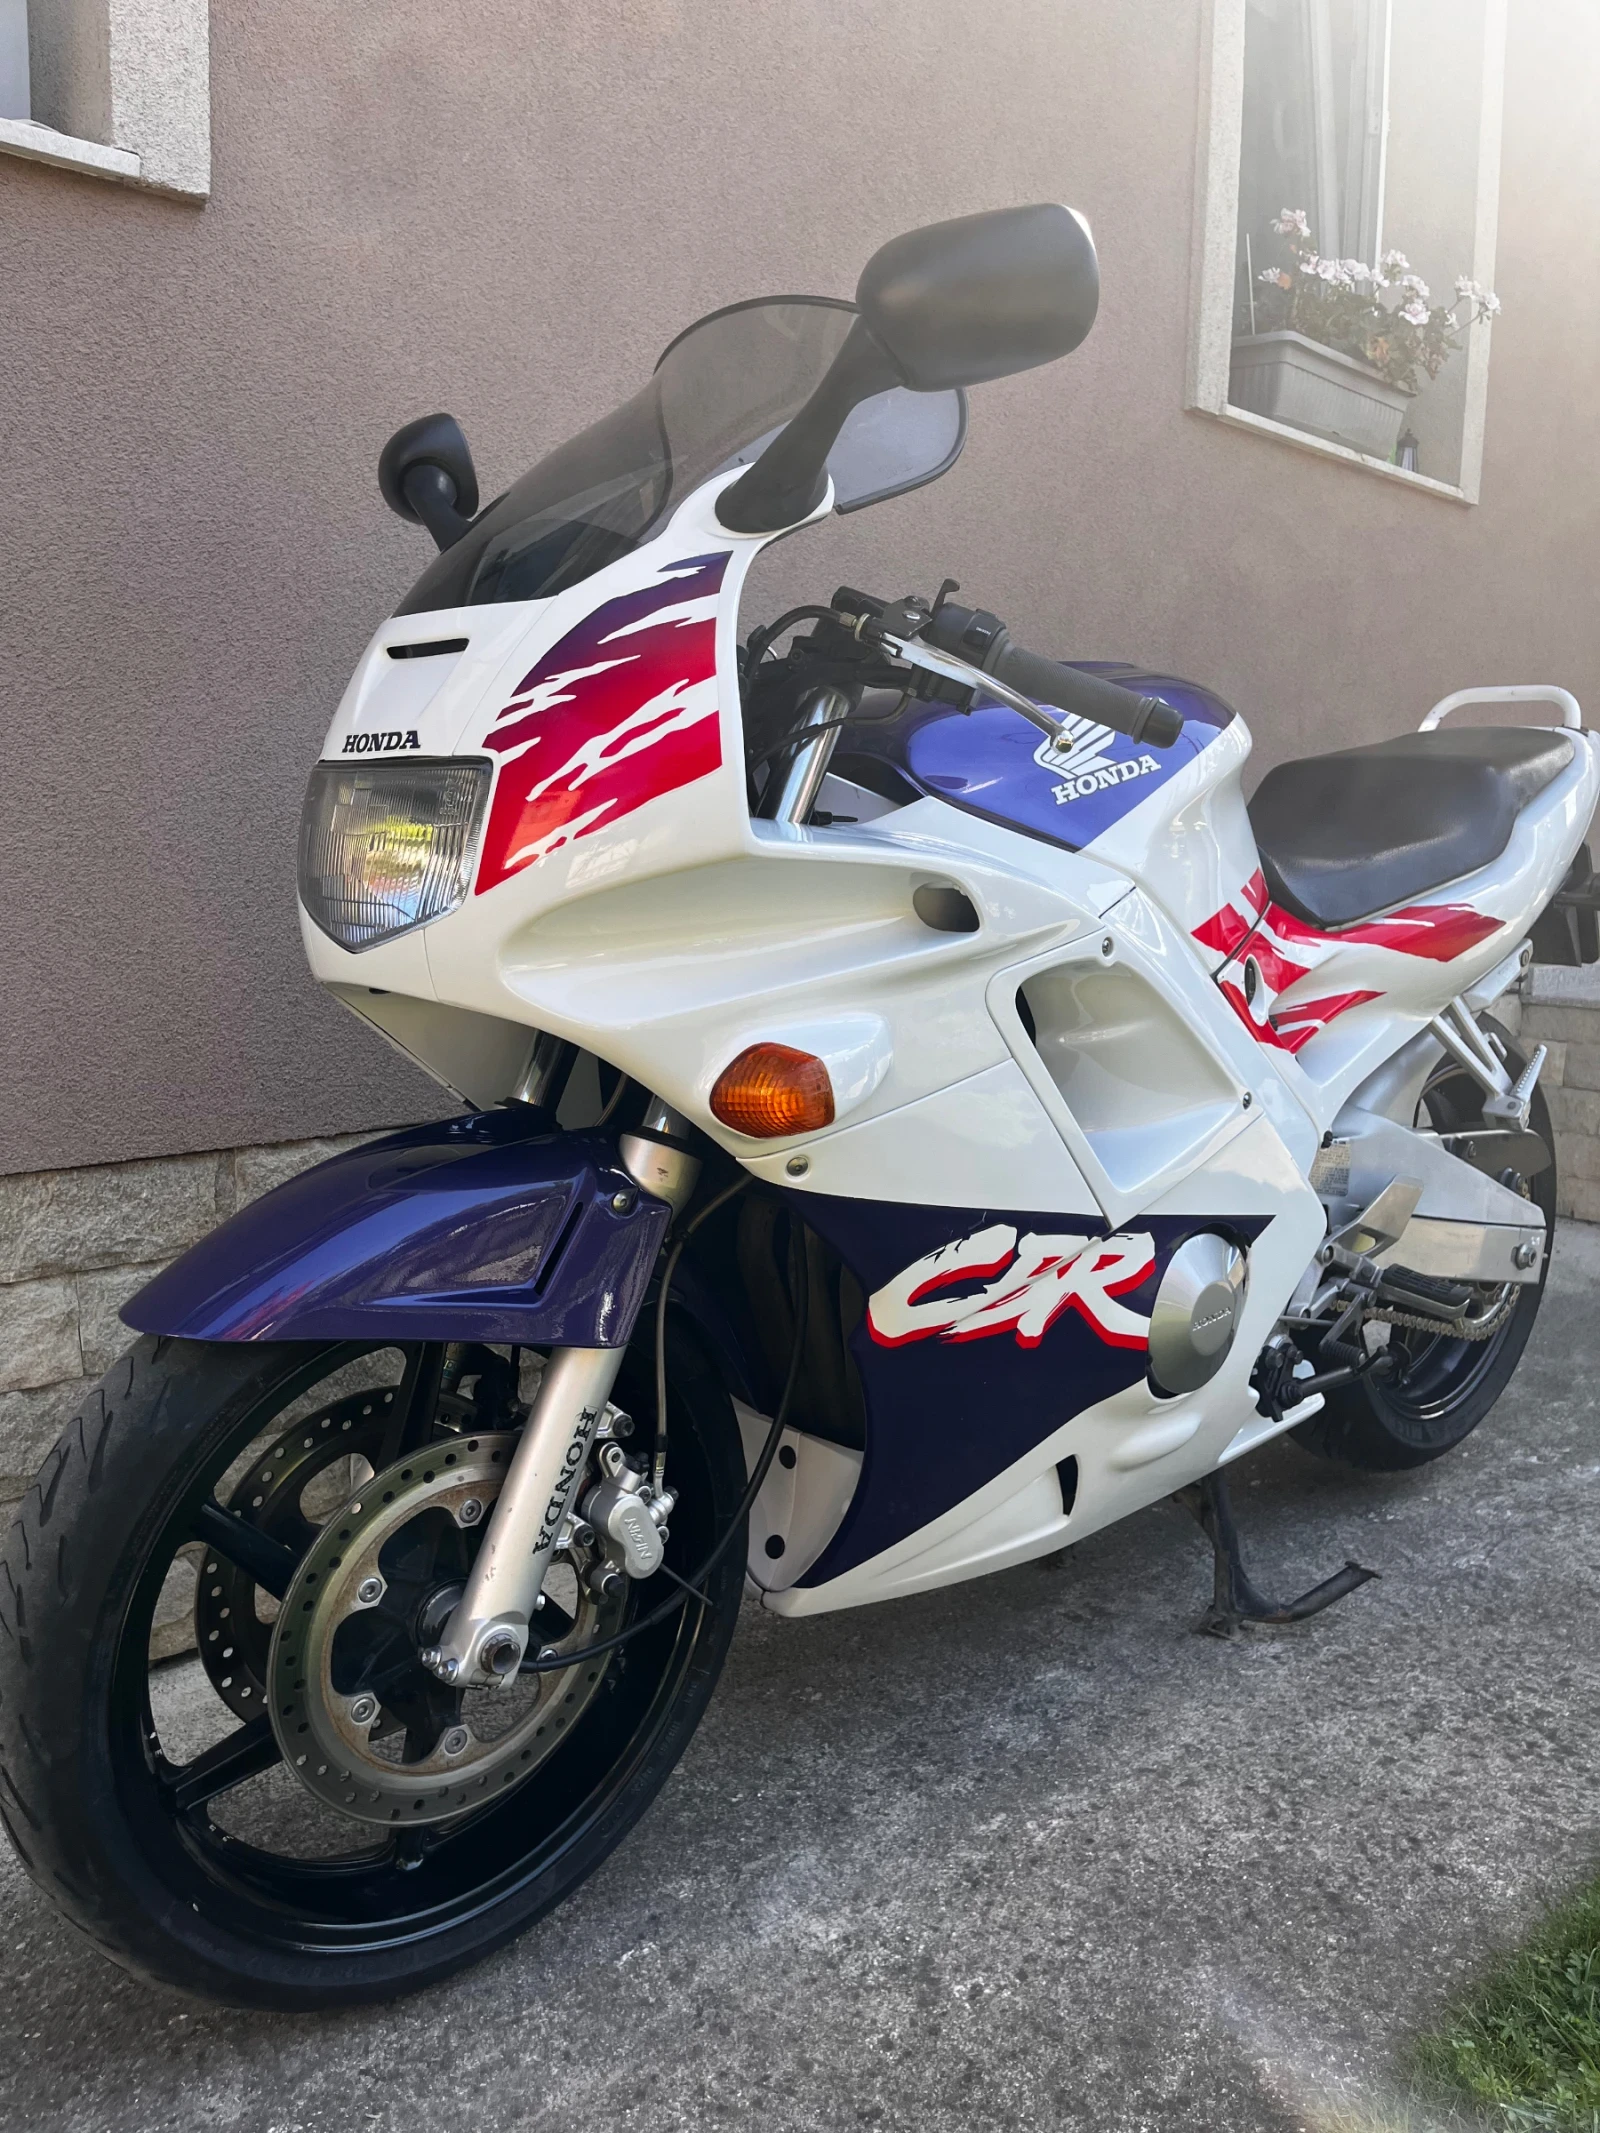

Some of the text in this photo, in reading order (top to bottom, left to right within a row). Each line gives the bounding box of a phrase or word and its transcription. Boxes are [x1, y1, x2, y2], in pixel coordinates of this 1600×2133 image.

[341, 730, 421, 753] HONDA
[1050, 754, 1162, 805] HONDA
[866, 1224, 1155, 1350] CBR
[1192, 1306, 1231, 1331] HONDA
[532, 1406, 598, 1555] HONDA
